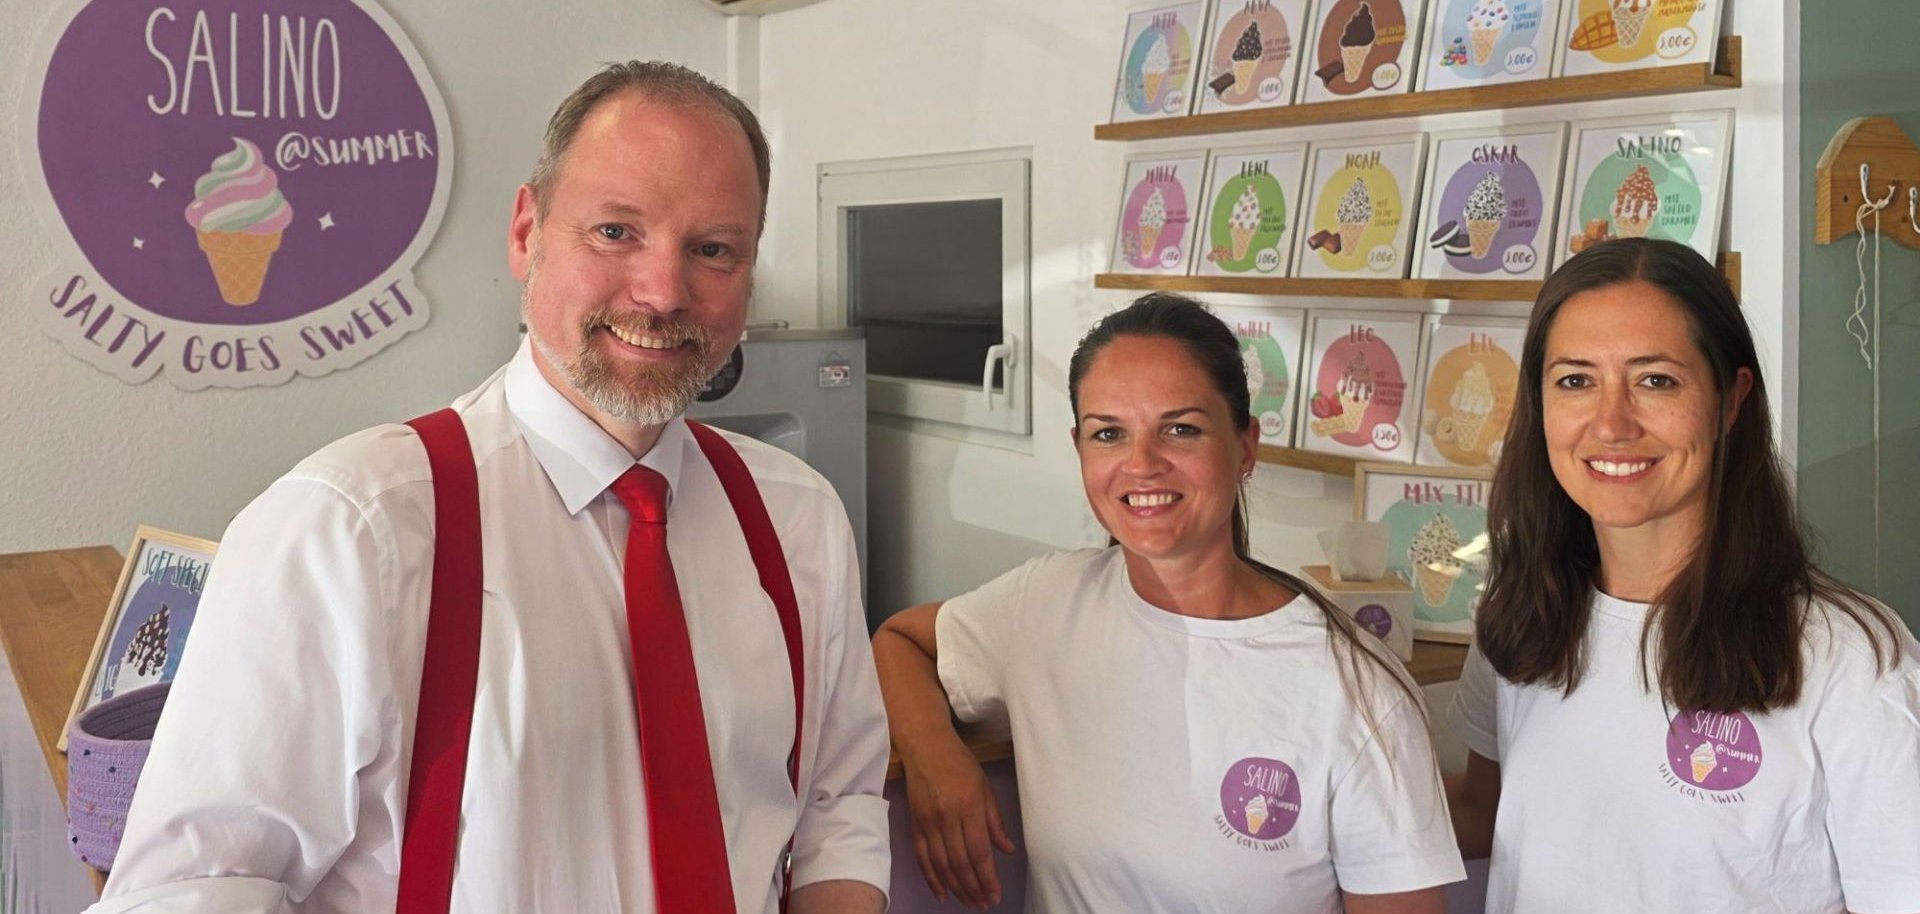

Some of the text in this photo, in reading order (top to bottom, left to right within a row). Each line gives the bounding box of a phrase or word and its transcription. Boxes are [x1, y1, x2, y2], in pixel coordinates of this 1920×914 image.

[145, 7, 341, 120] SALINO
[275, 129, 434, 171] @SUMMER
[1345, 151, 1381, 170] NOAH
[1472, 144, 1520, 163] OSKAR
[1616, 136, 1681, 159] SALINO
[49, 275, 414, 373] SALTY GOES SWEET
[1349, 324, 1375, 343] LEO
[1403, 482, 1443, 505] MIX
[142, 547, 175, 583] SOFT
[1691, 710, 1741, 745] SALINO
[1244, 764, 1289, 797] SALINO
